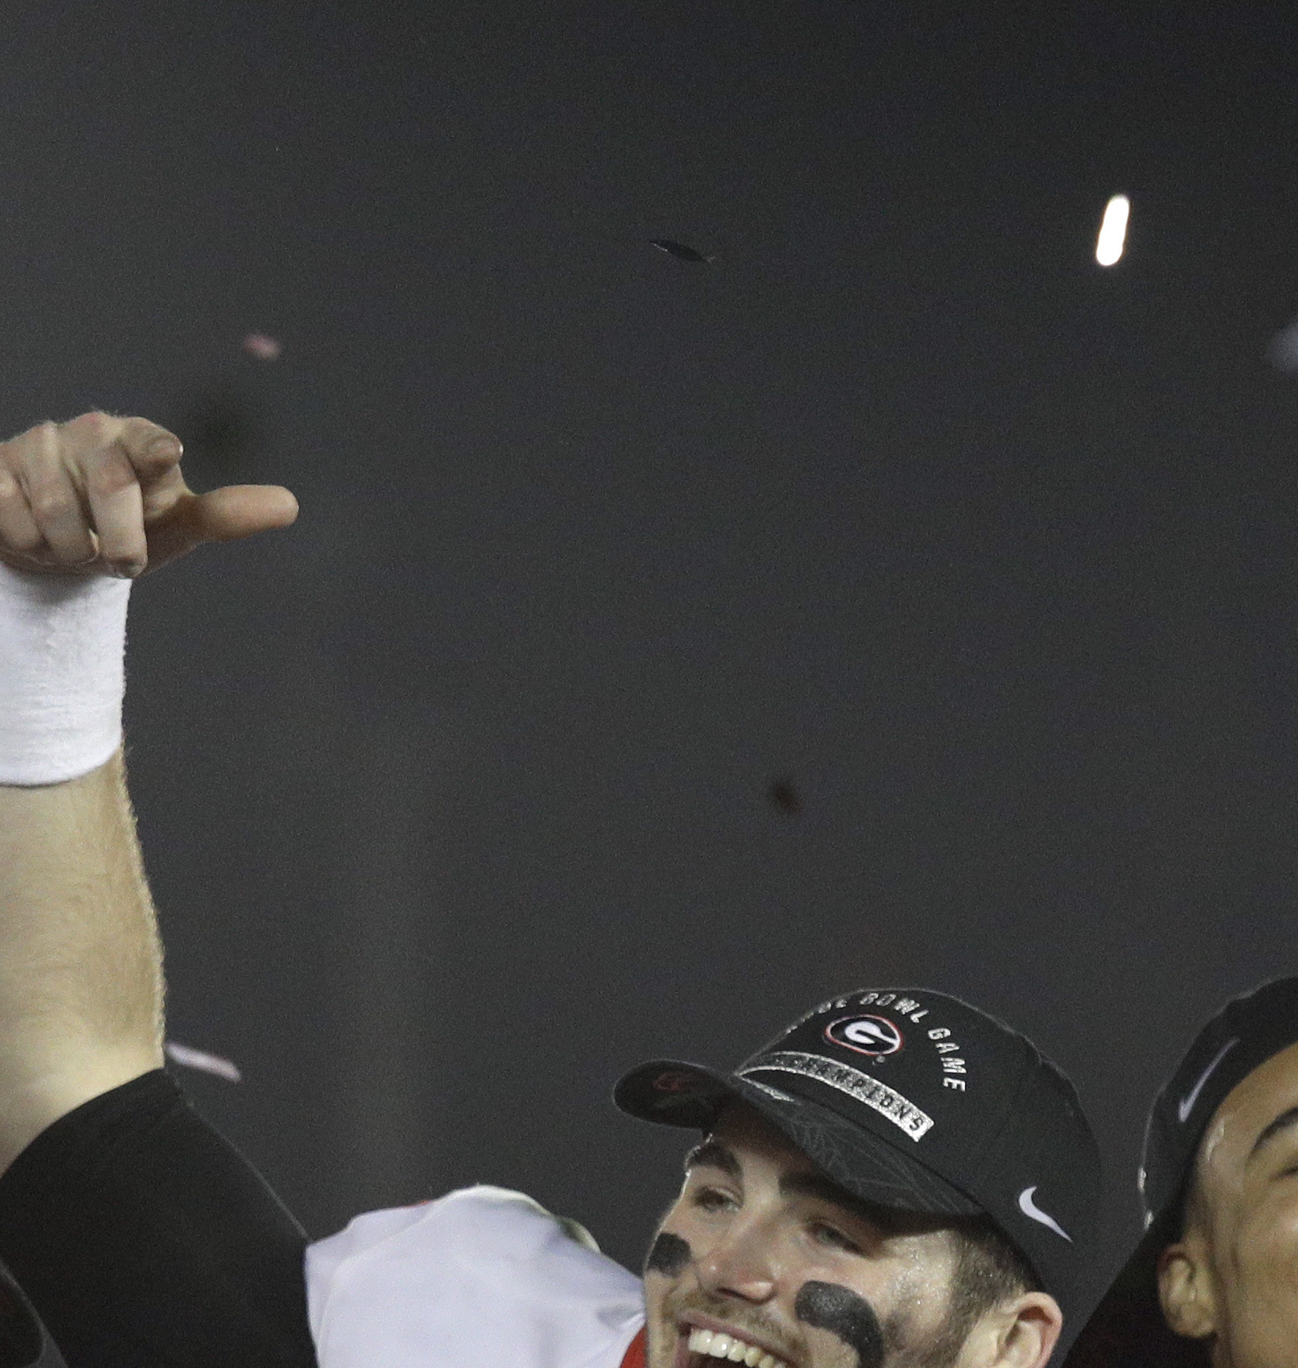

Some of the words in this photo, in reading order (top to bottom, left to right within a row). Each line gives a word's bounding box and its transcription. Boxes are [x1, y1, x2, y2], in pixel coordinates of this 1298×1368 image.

[860, 992, 930, 1024] BOWL
[927, 1027, 967, 1092] GAME
[773, 1055, 925, 1133] MPIONS
